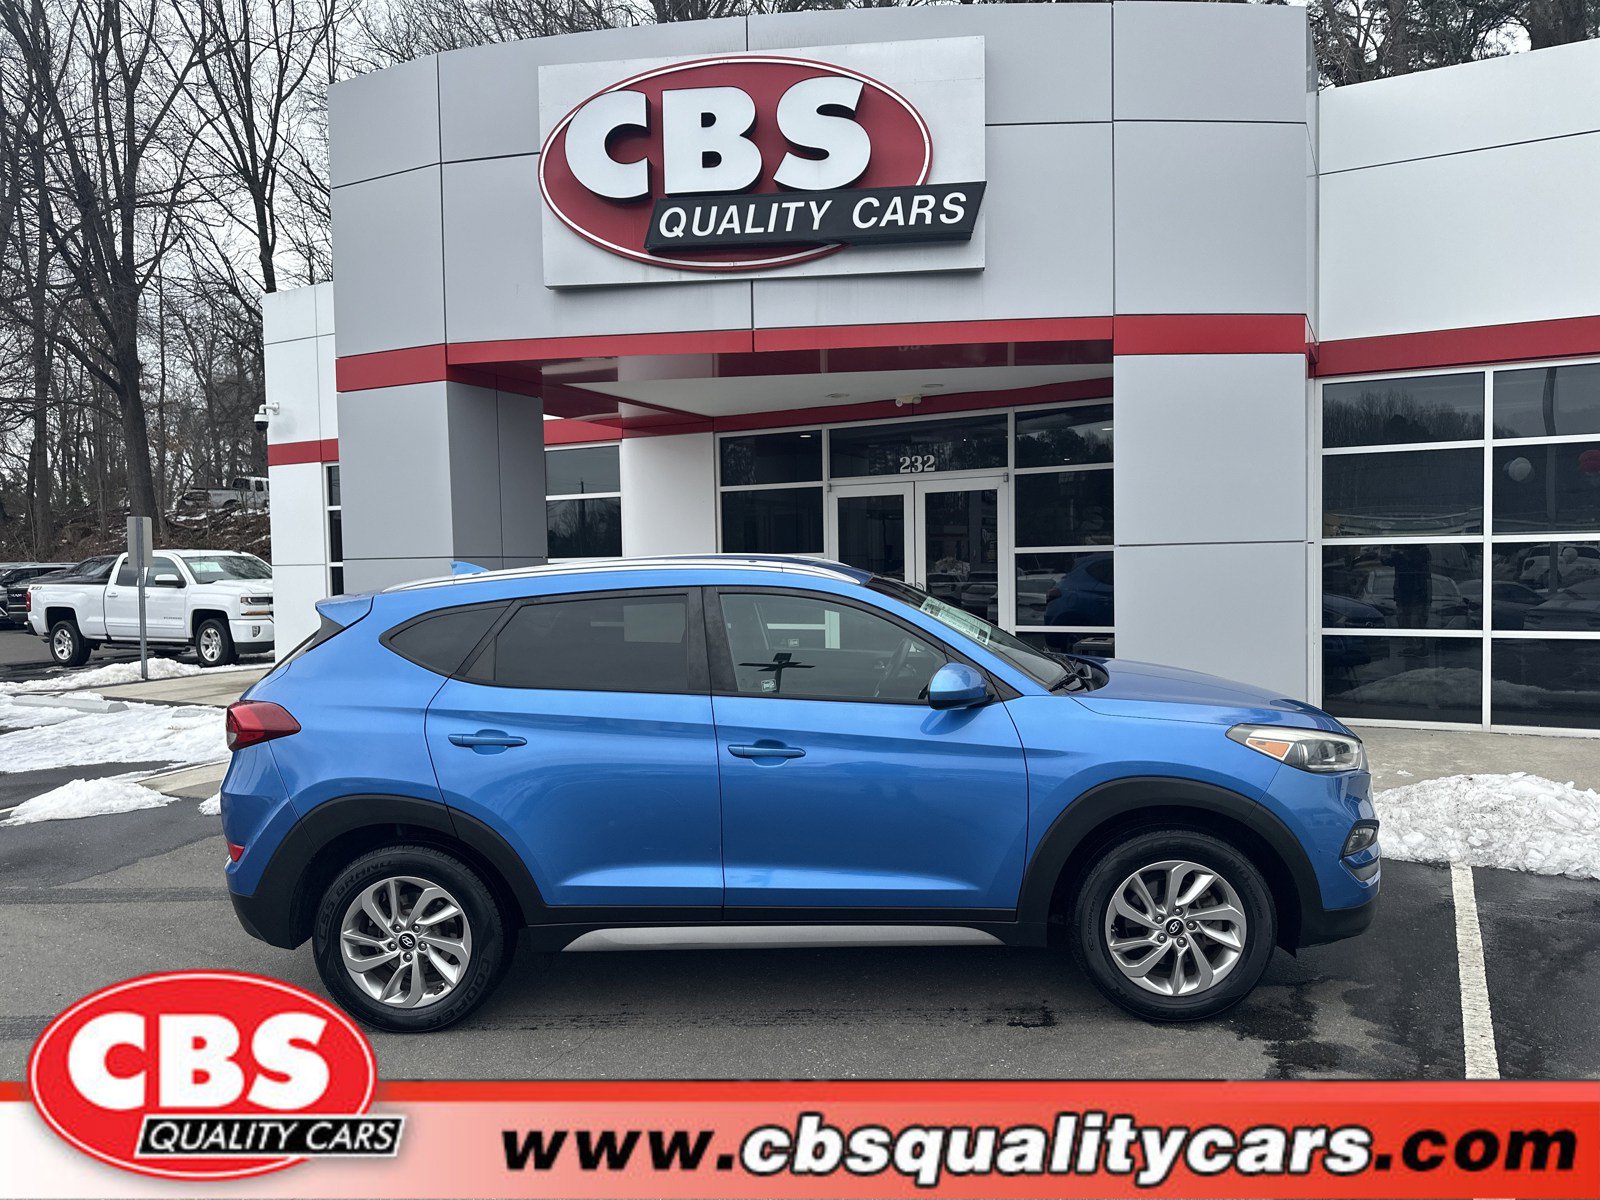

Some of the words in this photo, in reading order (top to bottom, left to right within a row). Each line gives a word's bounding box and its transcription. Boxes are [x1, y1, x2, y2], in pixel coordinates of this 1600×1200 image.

[564, 76, 873, 201] CBS
[658, 199, 833, 239] QUALITY
[852, 191, 968, 230] CARS
[899, 454, 936, 474] 232
